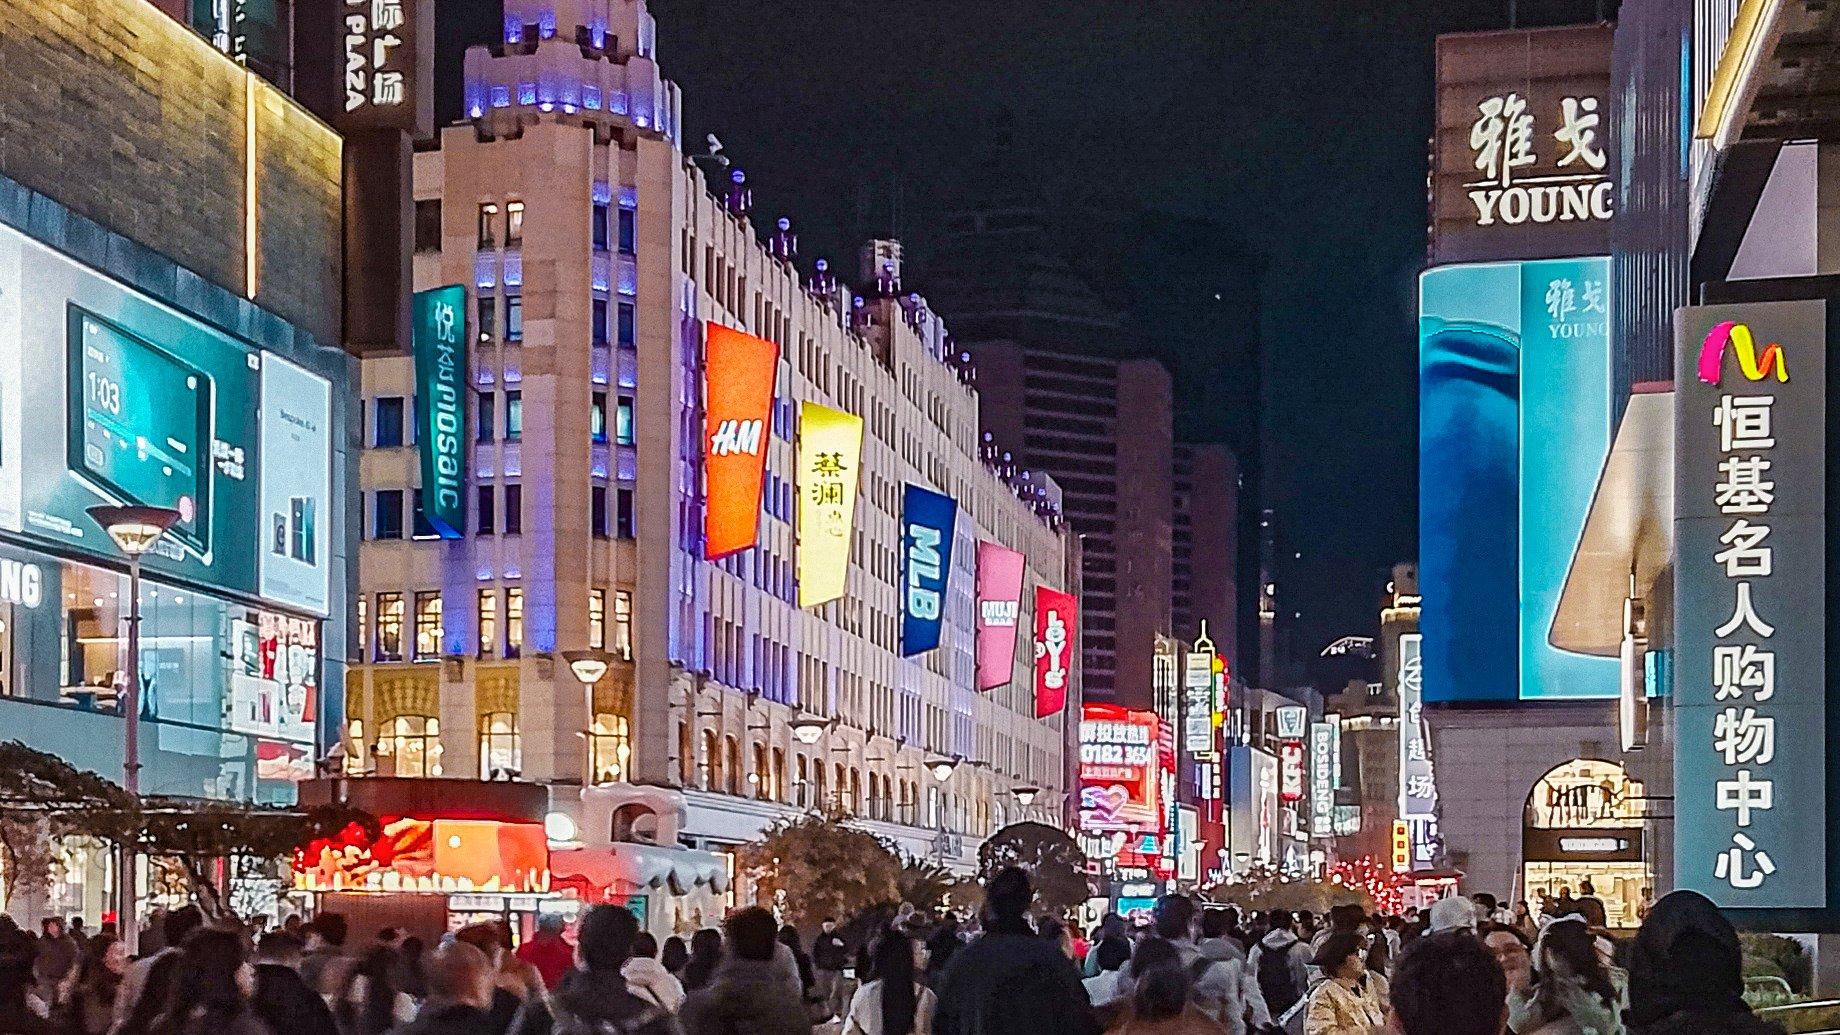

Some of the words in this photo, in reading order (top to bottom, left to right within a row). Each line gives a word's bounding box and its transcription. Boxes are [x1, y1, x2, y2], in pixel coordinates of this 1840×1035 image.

[345, 14, 367, 113] PLAZA
[1469, 93, 1607, 187] 雅戈
[88, 371, 120, 415] 1:03
[711, 419, 763, 457] H&M
[908, 523, 942, 621] MLB
[981, 600, 1019, 619] MUJI
[1712, 394, 1776, 890] 恒基名人购物中心
[1282, 745, 1302, 794] KFC
[1316, 730, 1331, 815] BOSIDENG
